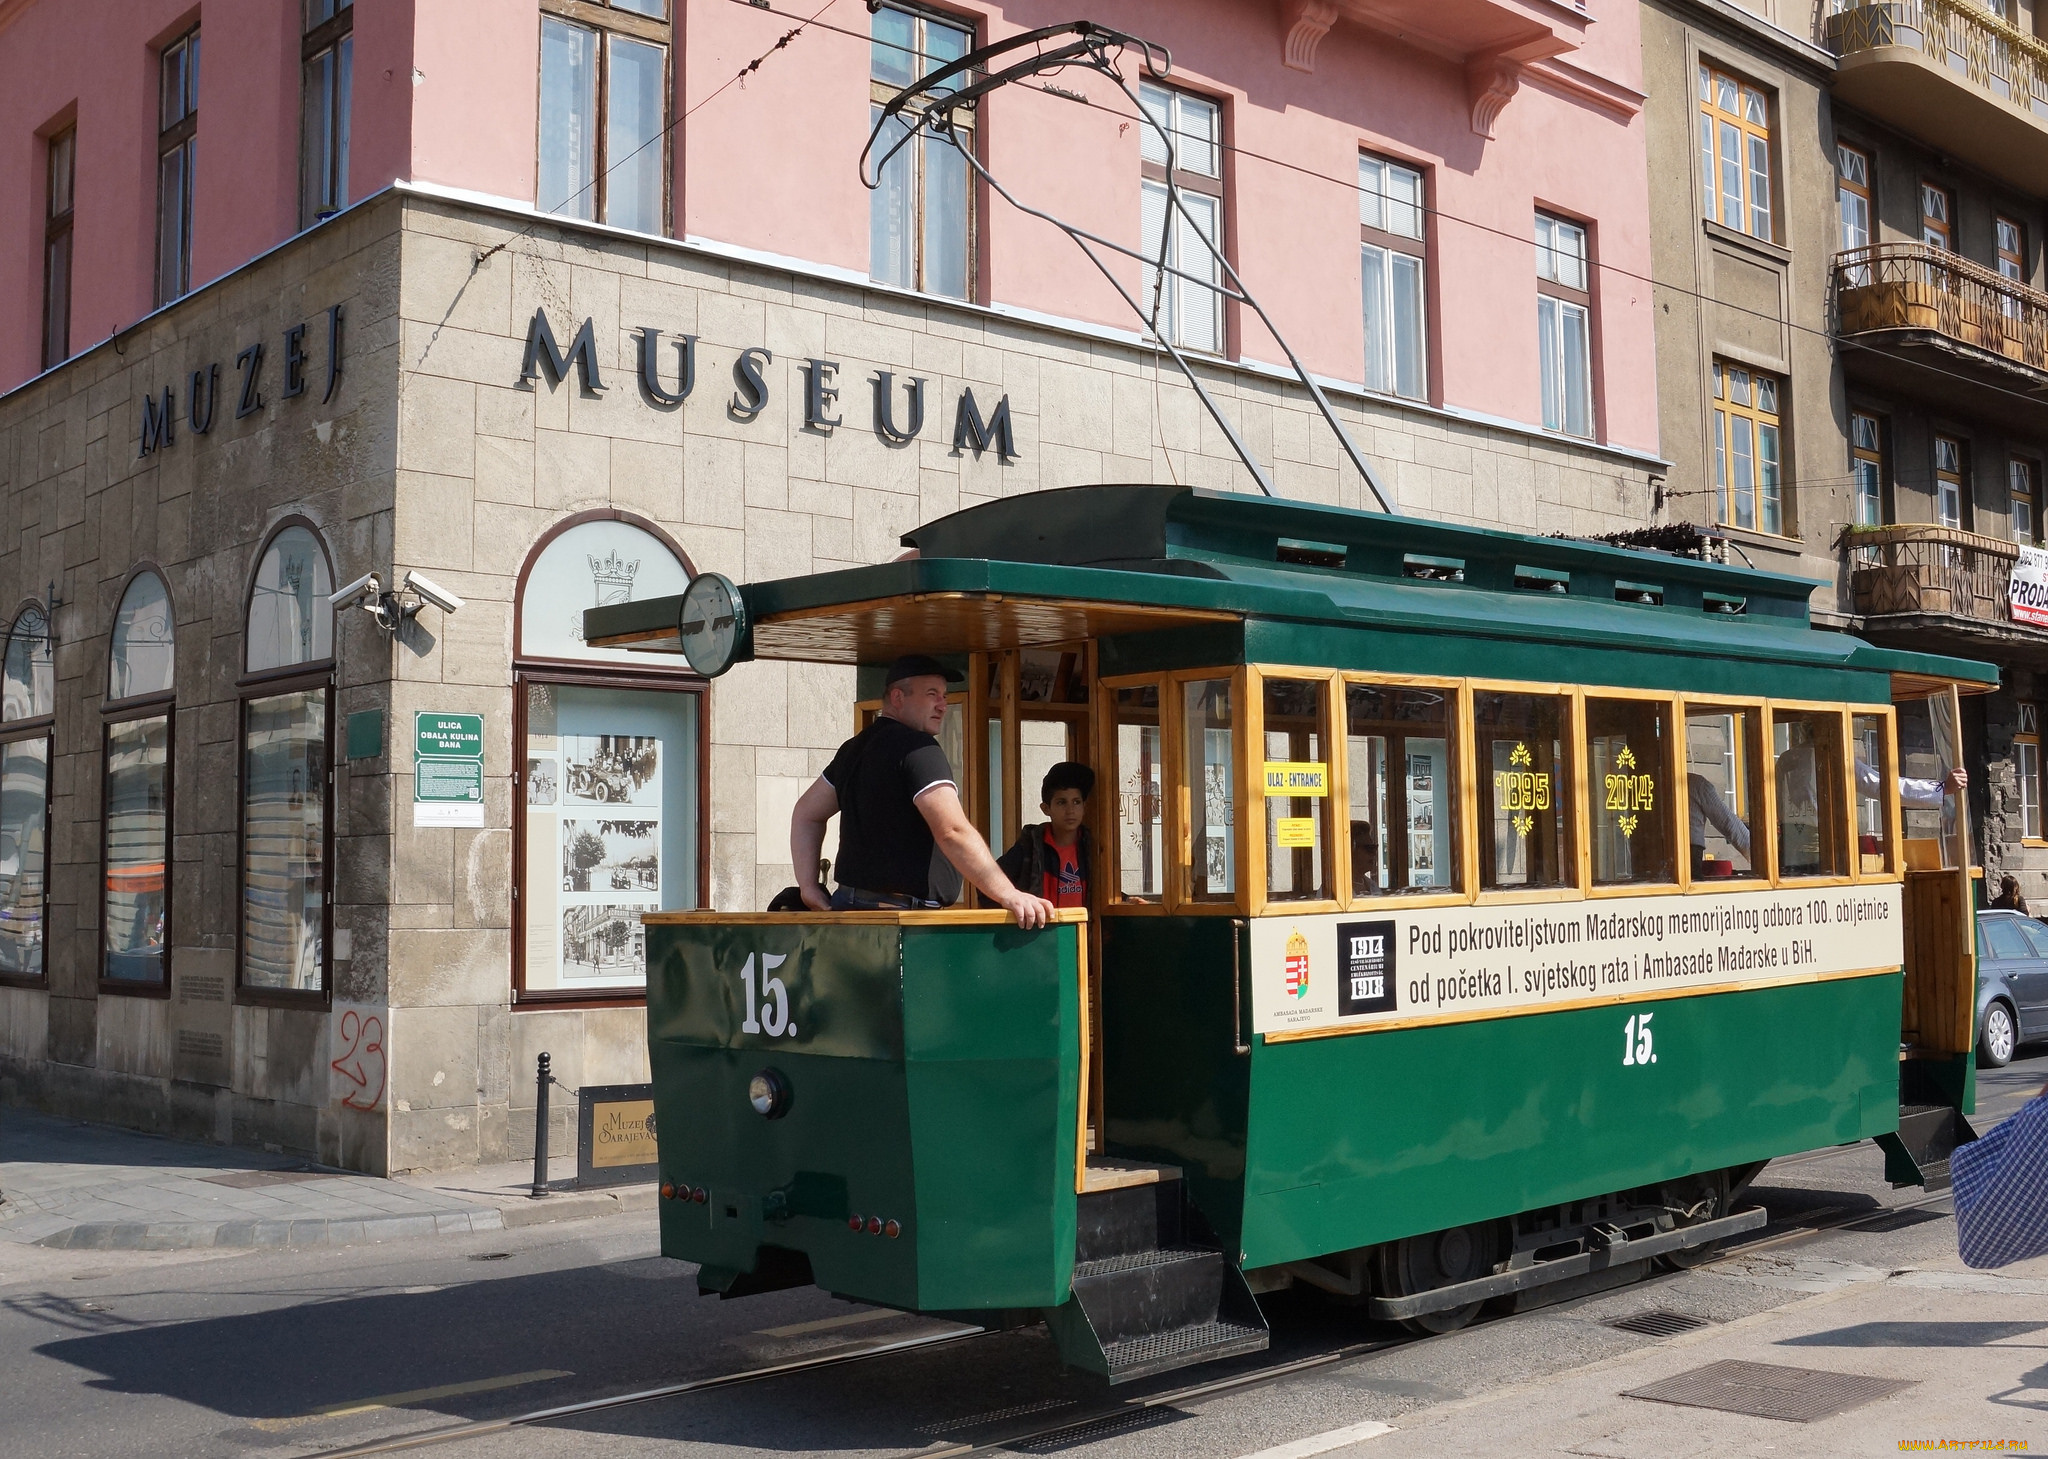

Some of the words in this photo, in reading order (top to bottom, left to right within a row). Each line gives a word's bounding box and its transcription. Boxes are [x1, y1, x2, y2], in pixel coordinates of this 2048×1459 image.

[138, 304, 343, 459] MUZEJ
[520, 306, 1022, 458] MUSEUM
[421, 731, 447, 740] OBALA
[450, 733, 479, 741] KULINA
[438, 721, 462, 730] ULICA
[439, 741, 461, 749] BANA
[1267, 772, 1283, 787] ULAZ
[1289, 772, 1322, 787] ENTRANCE
[1496, 772, 1549, 811] 1895
[1605, 774, 1654, 811] 2014
[1409, 923, 1442, 955] Pod
[1449, 917, 1581, 959] pokroviteljstvom
[1586, 910, 1663, 942] Mađarskog
[1668, 905, 1759, 937] memorijalnog
[1763, 902, 1803, 928] odbora
[1806, 899, 1832, 925] 100.
[1836, 897, 1889, 927] obljetnice
[1350, 935, 1384, 959] 1914
[1350, 976, 1384, 1000] 1918
[1409, 972, 1430, 1004] od
[1437, 967, 1501, 1008] početka
[1507, 965, 1518, 994] I.
[1524, 960, 1596, 997] svjetskog
[1601, 956, 1629, 985] rata
[1634, 954, 1638, 981] i
[1643, 948, 1713, 979] Ambasade
[1718, 943, 1778, 973] Mađarske
[1781, 946, 1789, 966] u
[1792, 939, 1817, 965] BiH.
[741, 952, 797, 1037] 15.
[1623, 1012, 1657, 1066] 15.
[599, 1122, 651, 1144] SARAJEVA
